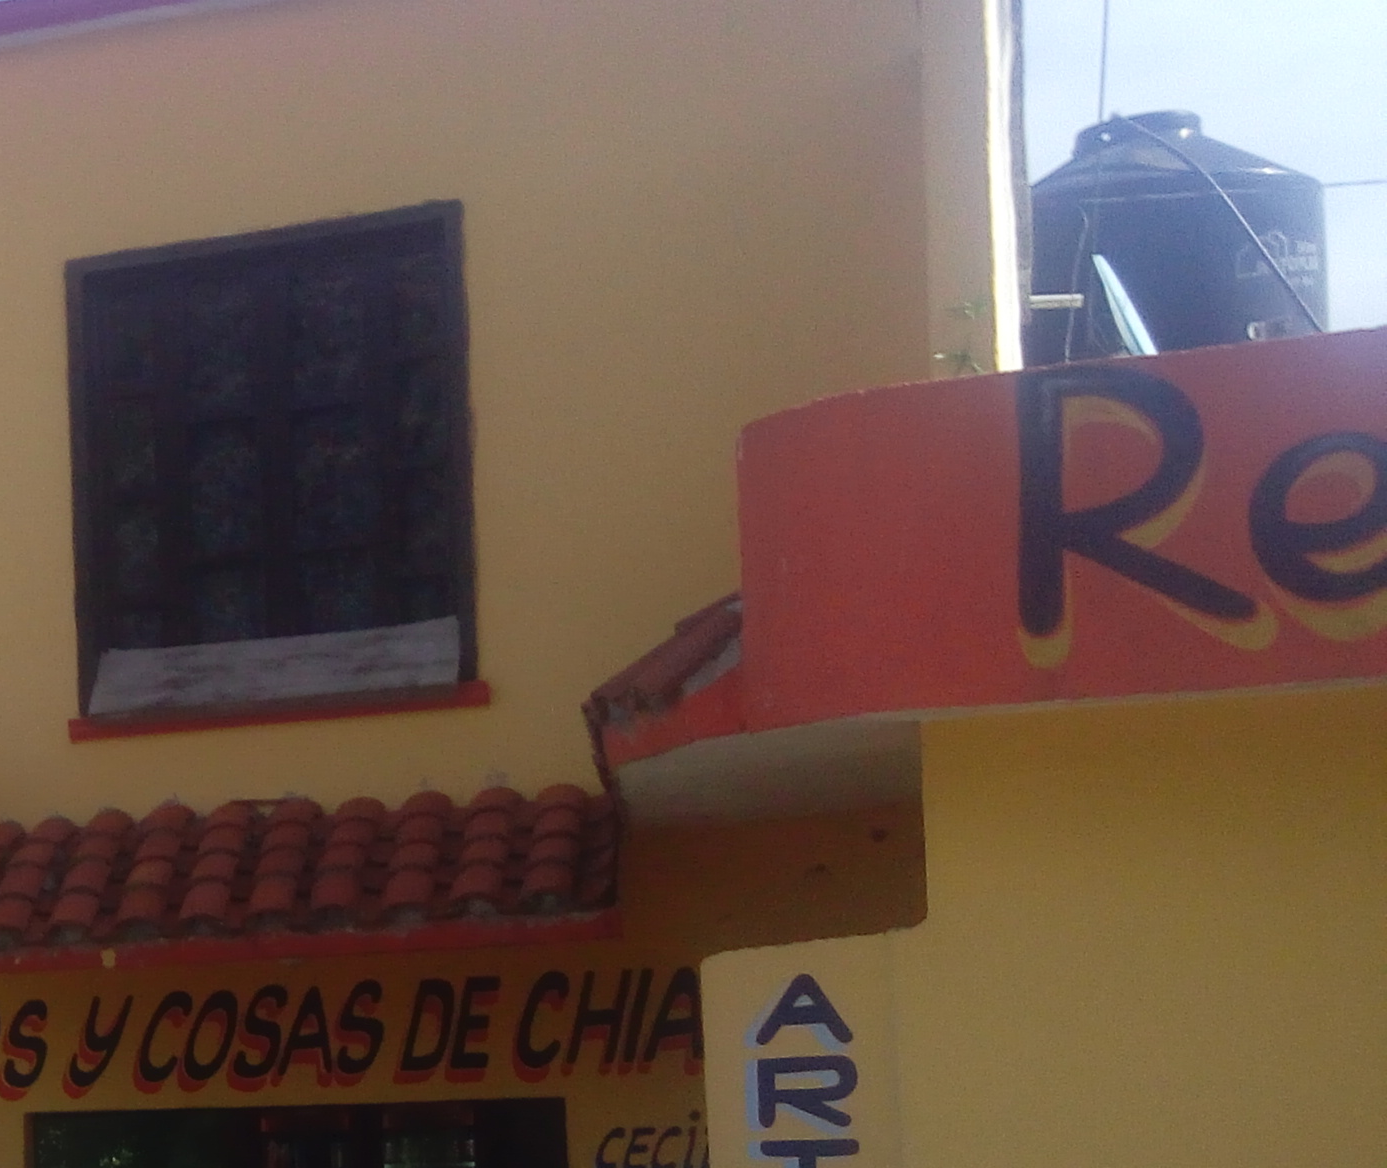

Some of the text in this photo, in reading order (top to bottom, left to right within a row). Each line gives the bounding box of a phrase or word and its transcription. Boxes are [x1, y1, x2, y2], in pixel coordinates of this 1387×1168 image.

[1014, 364, 1387, 642] Re
[133, 979, 385, 1092] COSAS
[393, 976, 501, 1084] DE
